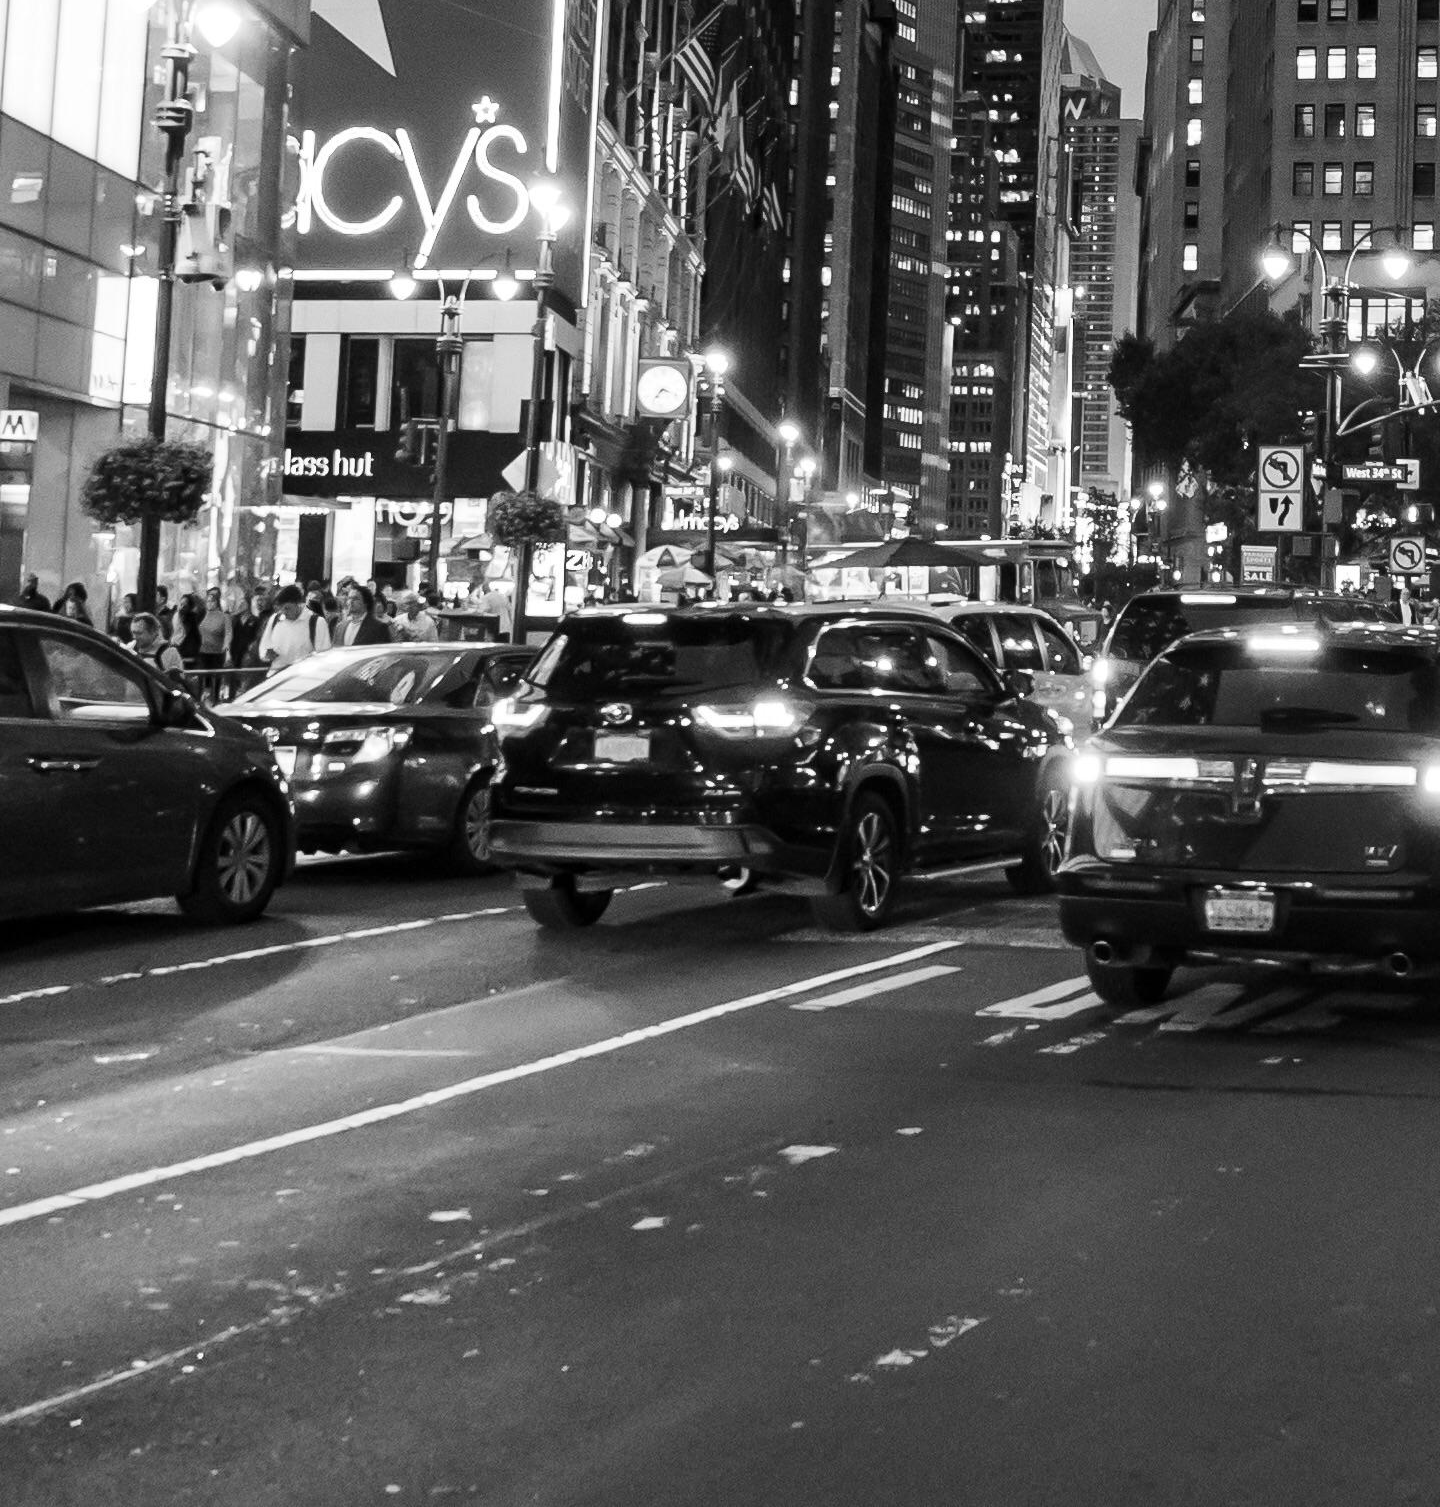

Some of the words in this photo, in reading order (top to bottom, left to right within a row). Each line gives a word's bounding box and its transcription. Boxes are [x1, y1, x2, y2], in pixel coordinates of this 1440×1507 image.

[332, 448, 374, 477] hut
[1345, 467, 1371, 479] West
[1391, 468, 1403, 480] St
[1243, 572, 1273, 582] SALE
